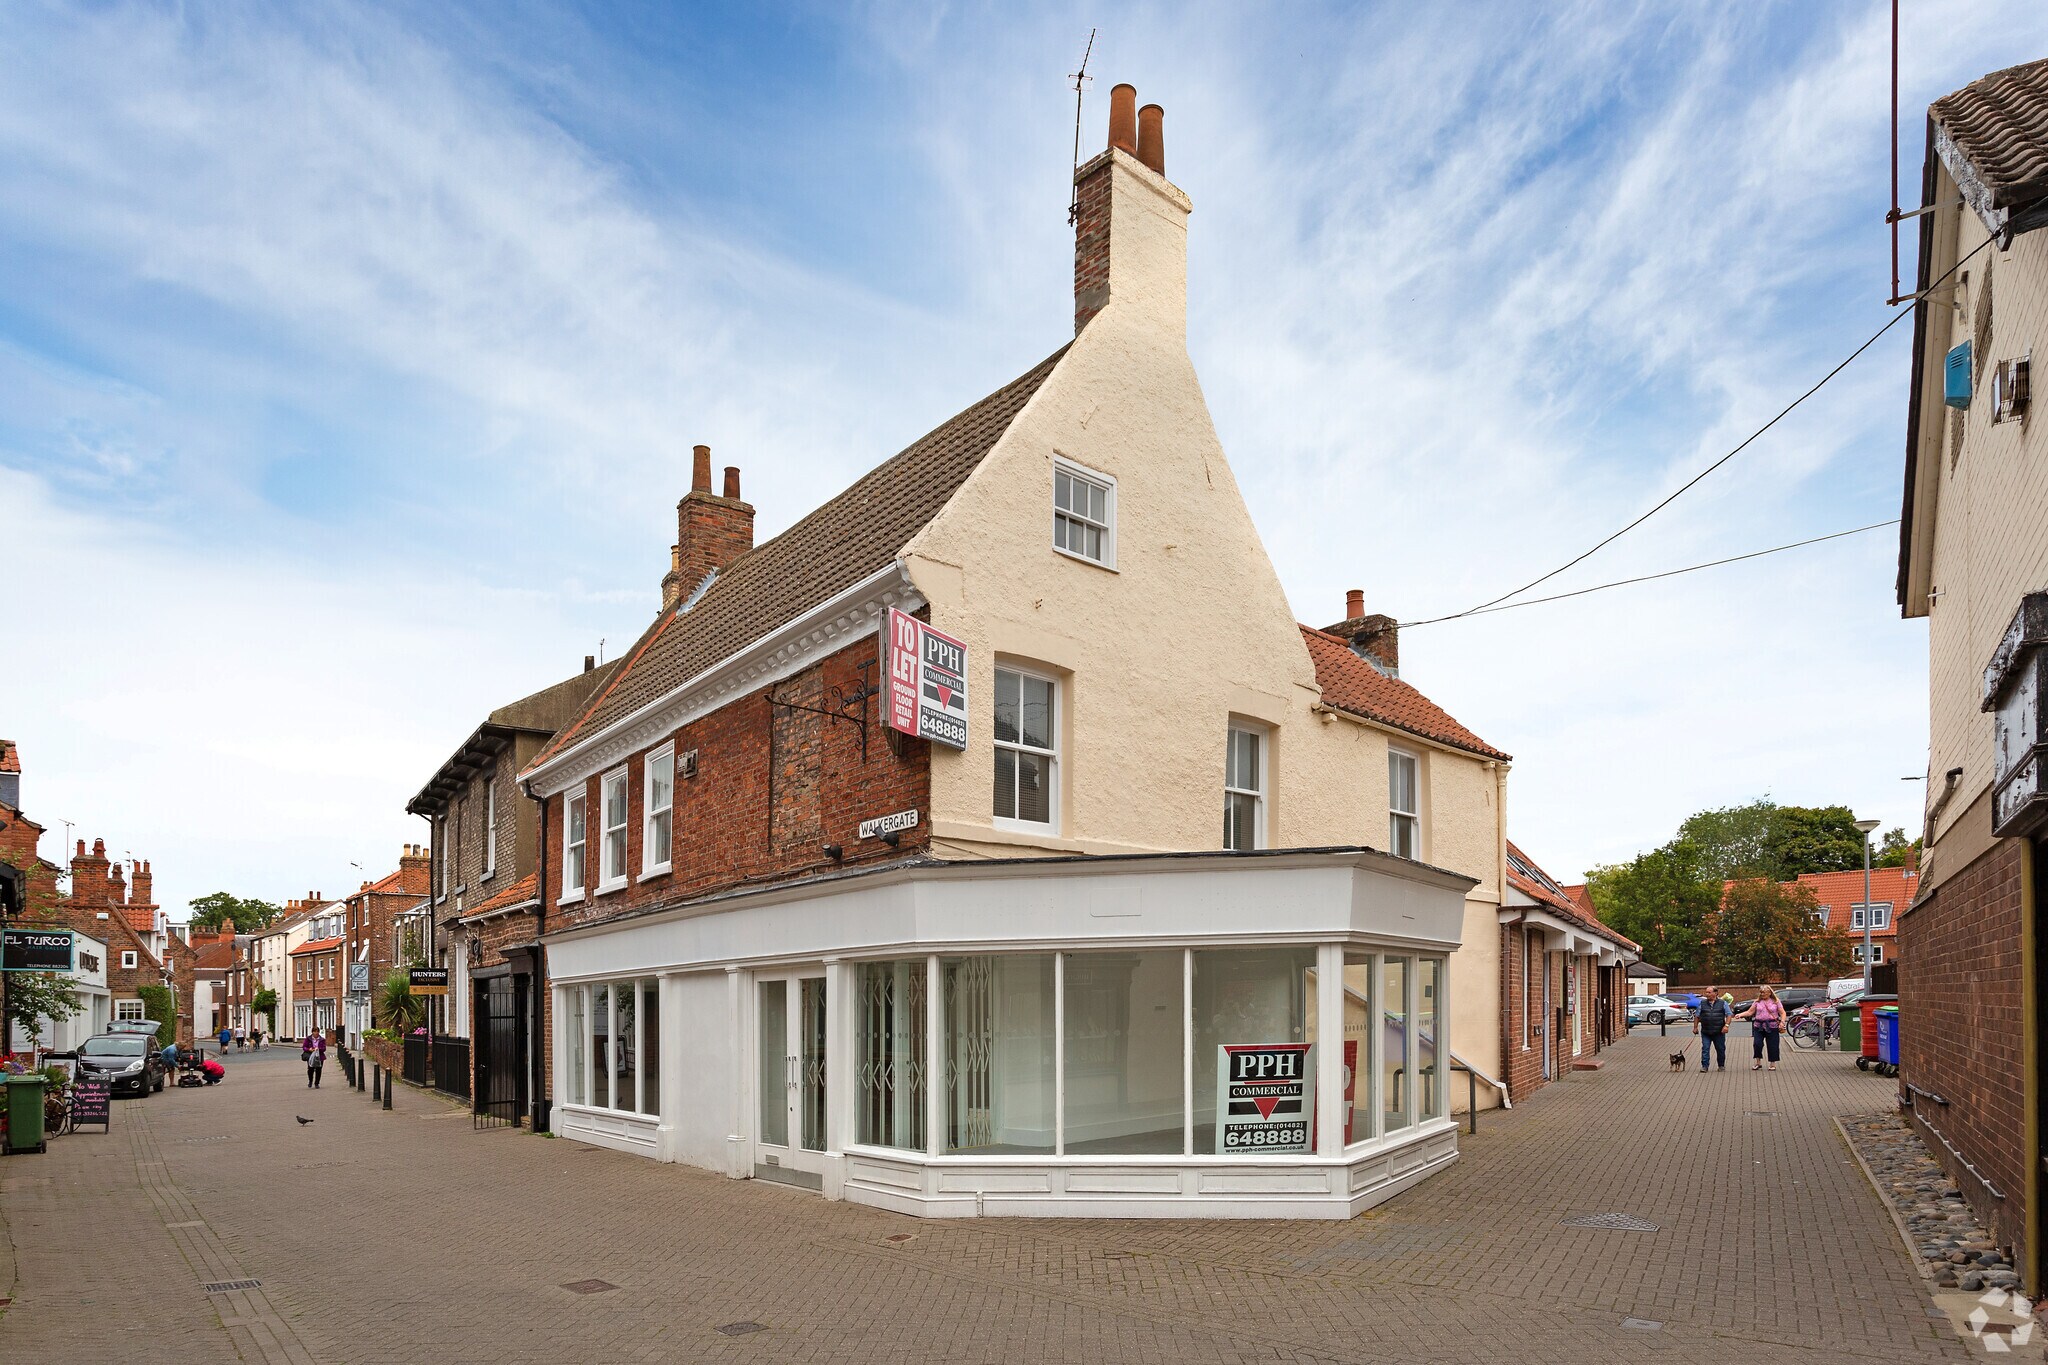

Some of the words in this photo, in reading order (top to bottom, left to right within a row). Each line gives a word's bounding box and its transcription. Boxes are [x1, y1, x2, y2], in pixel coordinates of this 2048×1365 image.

[897, 616, 915, 652] TO
[927, 636, 960, 672] PPH
[893, 647, 917, 685] LET
[924, 668, 963, 690] COMMERCIAL
[893, 681, 916, 698] GROUND
[895, 693, 913, 708] FLOOR
[895, 705, 913, 719] RETAIL
[897, 717, 911, 729] UNIT
[921, 714, 966, 742] 648888
[5, 936, 22, 944] EL
[25, 937, 70, 946] TURCO
[1237, 1053, 1297, 1078] PPH
[1232, 1085, 1300, 1096] COMMERCIAL
[1225, 1129, 1305, 1146] 648888
[1225, 1144, 1305, 1154] www.pph-commercial.co.uk
